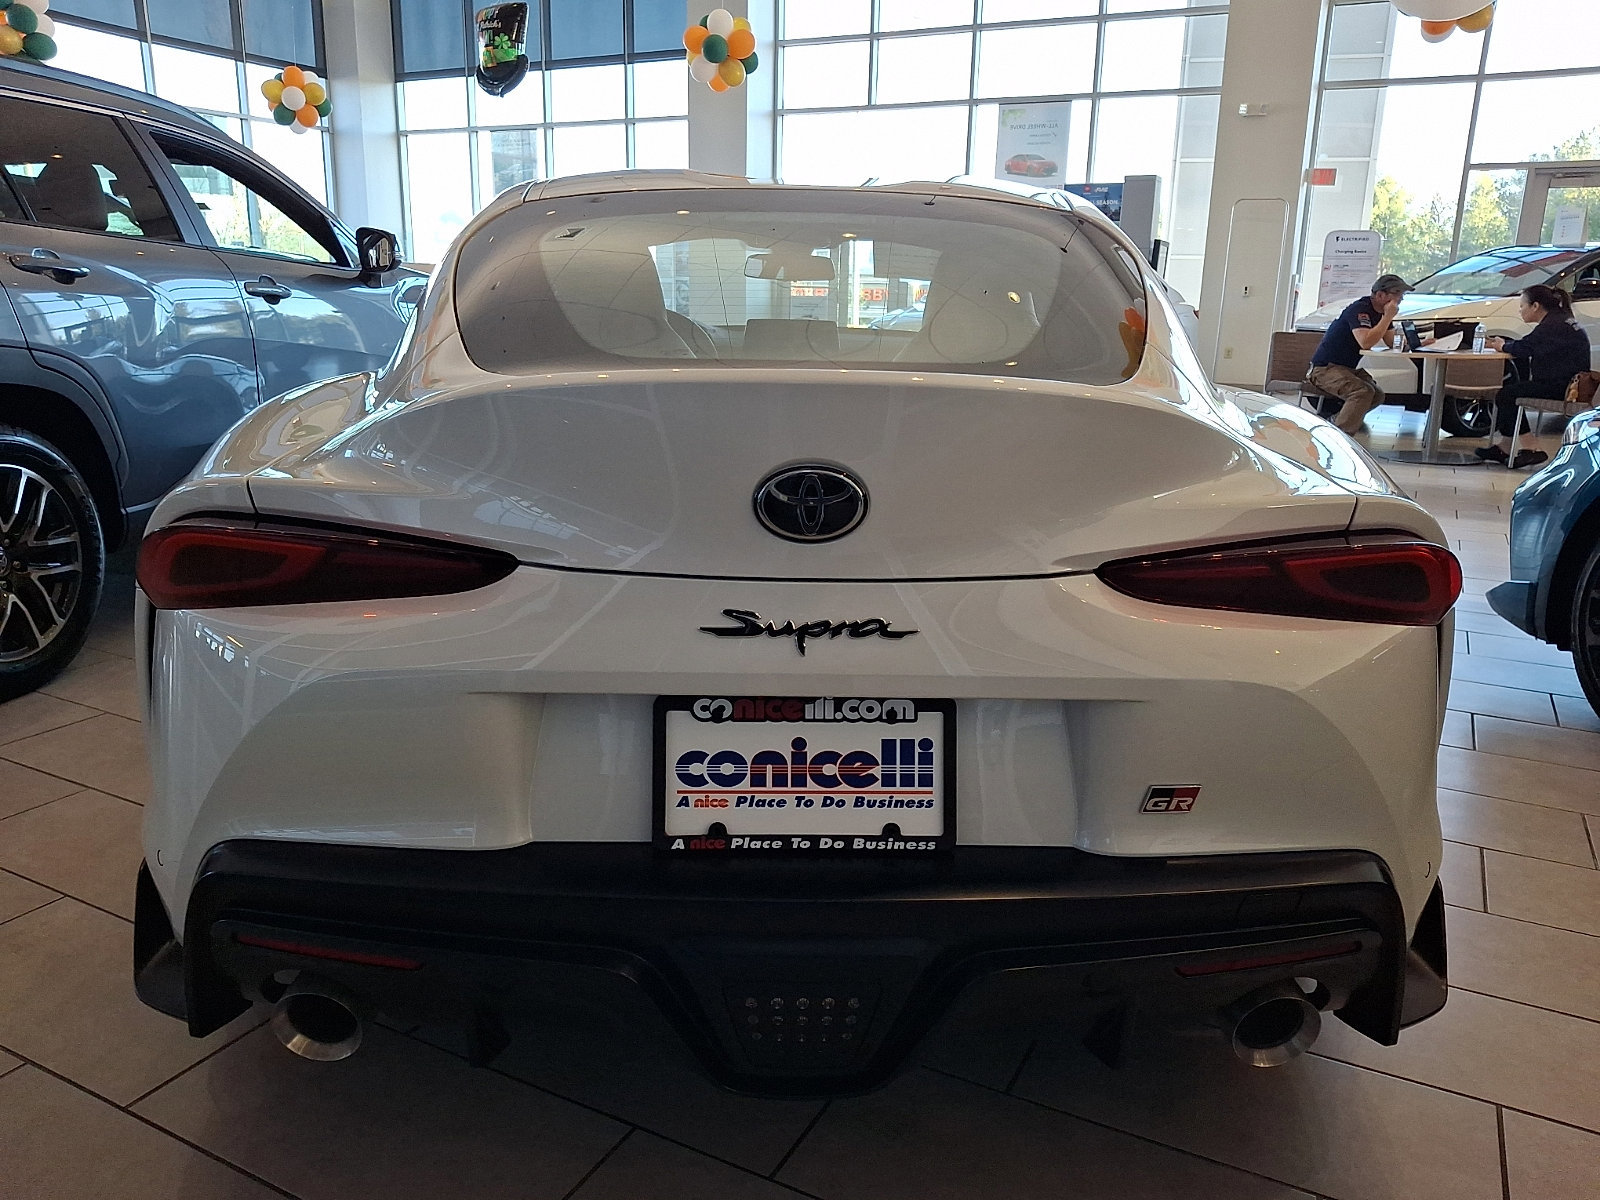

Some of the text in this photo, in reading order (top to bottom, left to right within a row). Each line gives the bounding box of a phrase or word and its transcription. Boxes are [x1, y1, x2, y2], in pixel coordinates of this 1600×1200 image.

[698, 608, 920, 656] Supra
[675, 736, 934, 789] conicelli
[676, 796, 934, 809] A nice Place To Do Business
[1145, 797, 1193, 810] GR
[671, 838, 936, 850] A nice Place To Do Business
